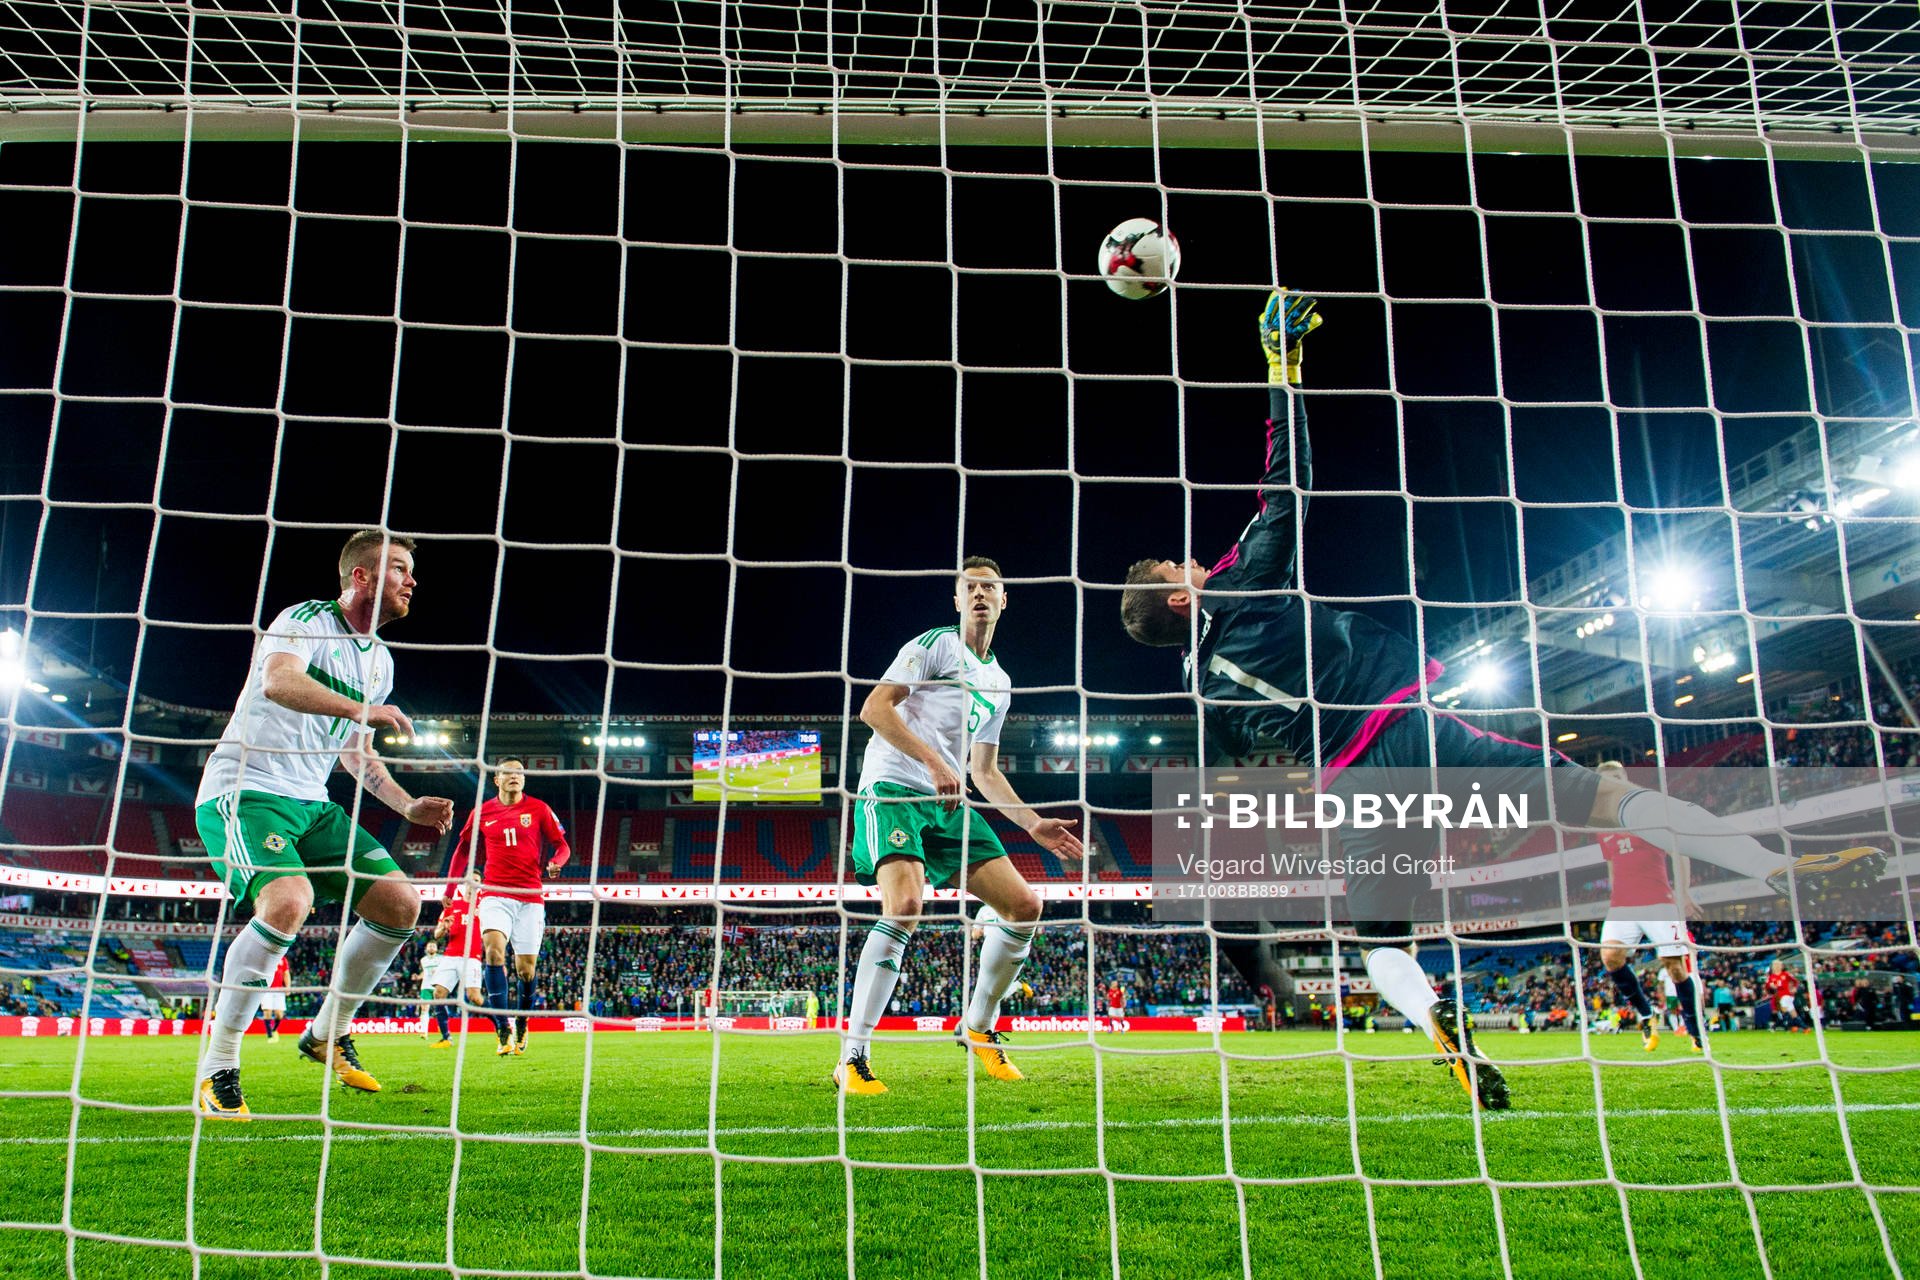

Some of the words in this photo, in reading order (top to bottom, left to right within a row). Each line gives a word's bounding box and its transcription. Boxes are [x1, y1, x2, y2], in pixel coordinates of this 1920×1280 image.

[580, 757, 643, 772] VG
[1042, 757, 1104, 772] VG
[1128, 757, 1187, 772] VG
[503, 828, 517, 846] 11
[1617, 837, 1633, 854] 21
[662, 887, 708, 898] VG
[730, 887, 776, 898] VG
[1011, 1016, 1130, 1032] thonhotes.no
